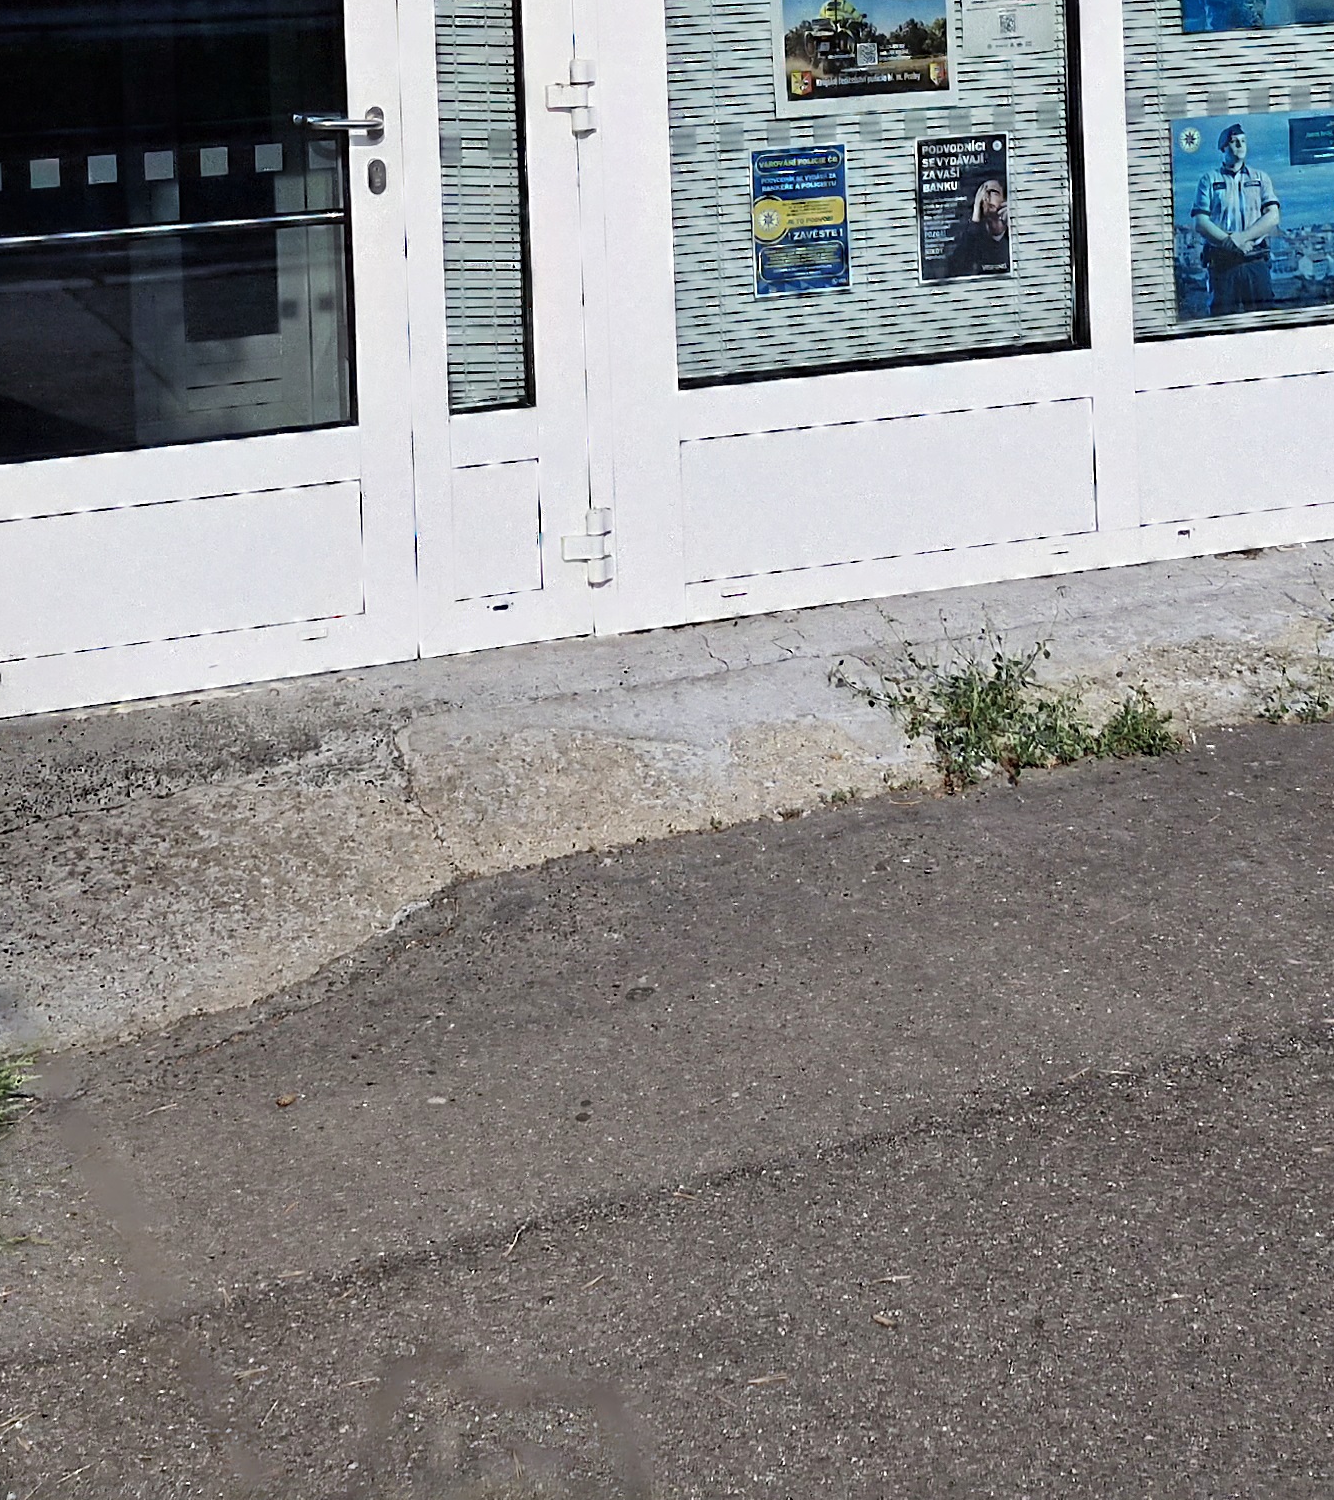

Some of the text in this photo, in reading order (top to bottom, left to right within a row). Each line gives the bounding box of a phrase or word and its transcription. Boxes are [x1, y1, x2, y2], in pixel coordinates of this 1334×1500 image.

[922, 140, 986, 155] PODVODNÍCI
[922, 157, 935, 167] SE
[922, 170, 935, 180] ZA
[922, 181, 958, 193] BANKU
